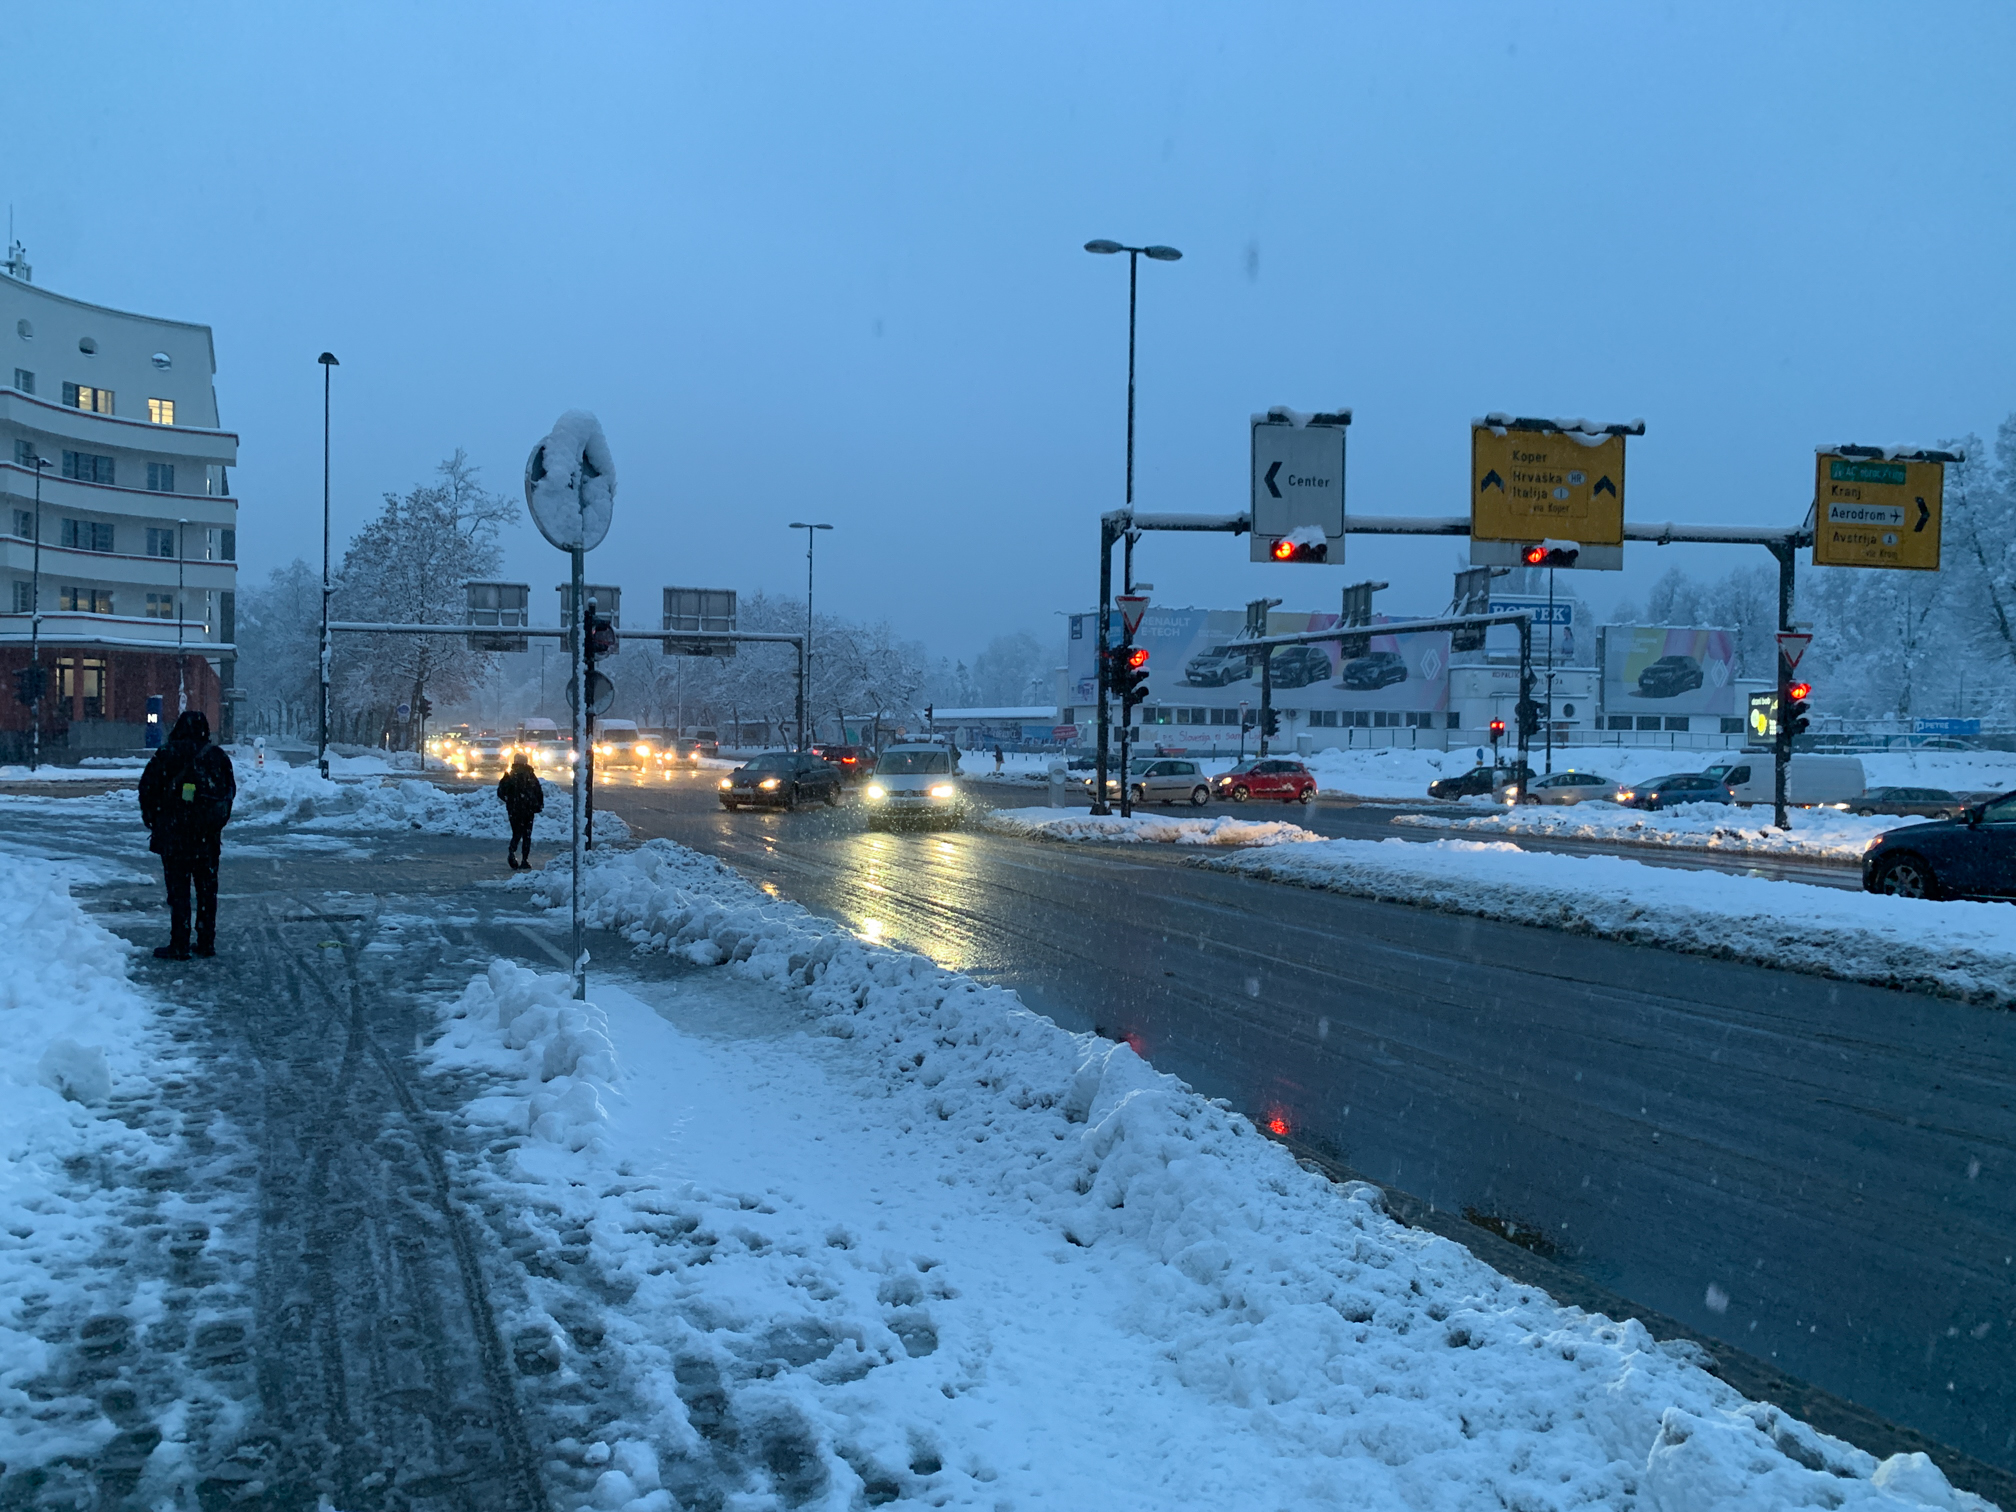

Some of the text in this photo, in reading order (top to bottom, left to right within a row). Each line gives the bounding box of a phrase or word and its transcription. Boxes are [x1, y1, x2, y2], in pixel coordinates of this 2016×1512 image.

[1512, 450, 1547, 464] Koper
[1288, 474, 1330, 487] Center
[1512, 471, 1582, 484] Hrvaška HR
[1512, 486, 1548, 501] Italija
[1831, 485, 1861, 500] Kranj
[1533, 503, 1570, 515] via Koper
[1831, 507, 1886, 521] Aerodrom
[1832, 531, 1877, 547] Avstrija
[1492, 606, 1565, 621] TEK
[1141, 616, 1191, 627] RENAULT
[1141, 627, 1180, 637] E-TECH
[1225, 732, 1244, 741] sam
